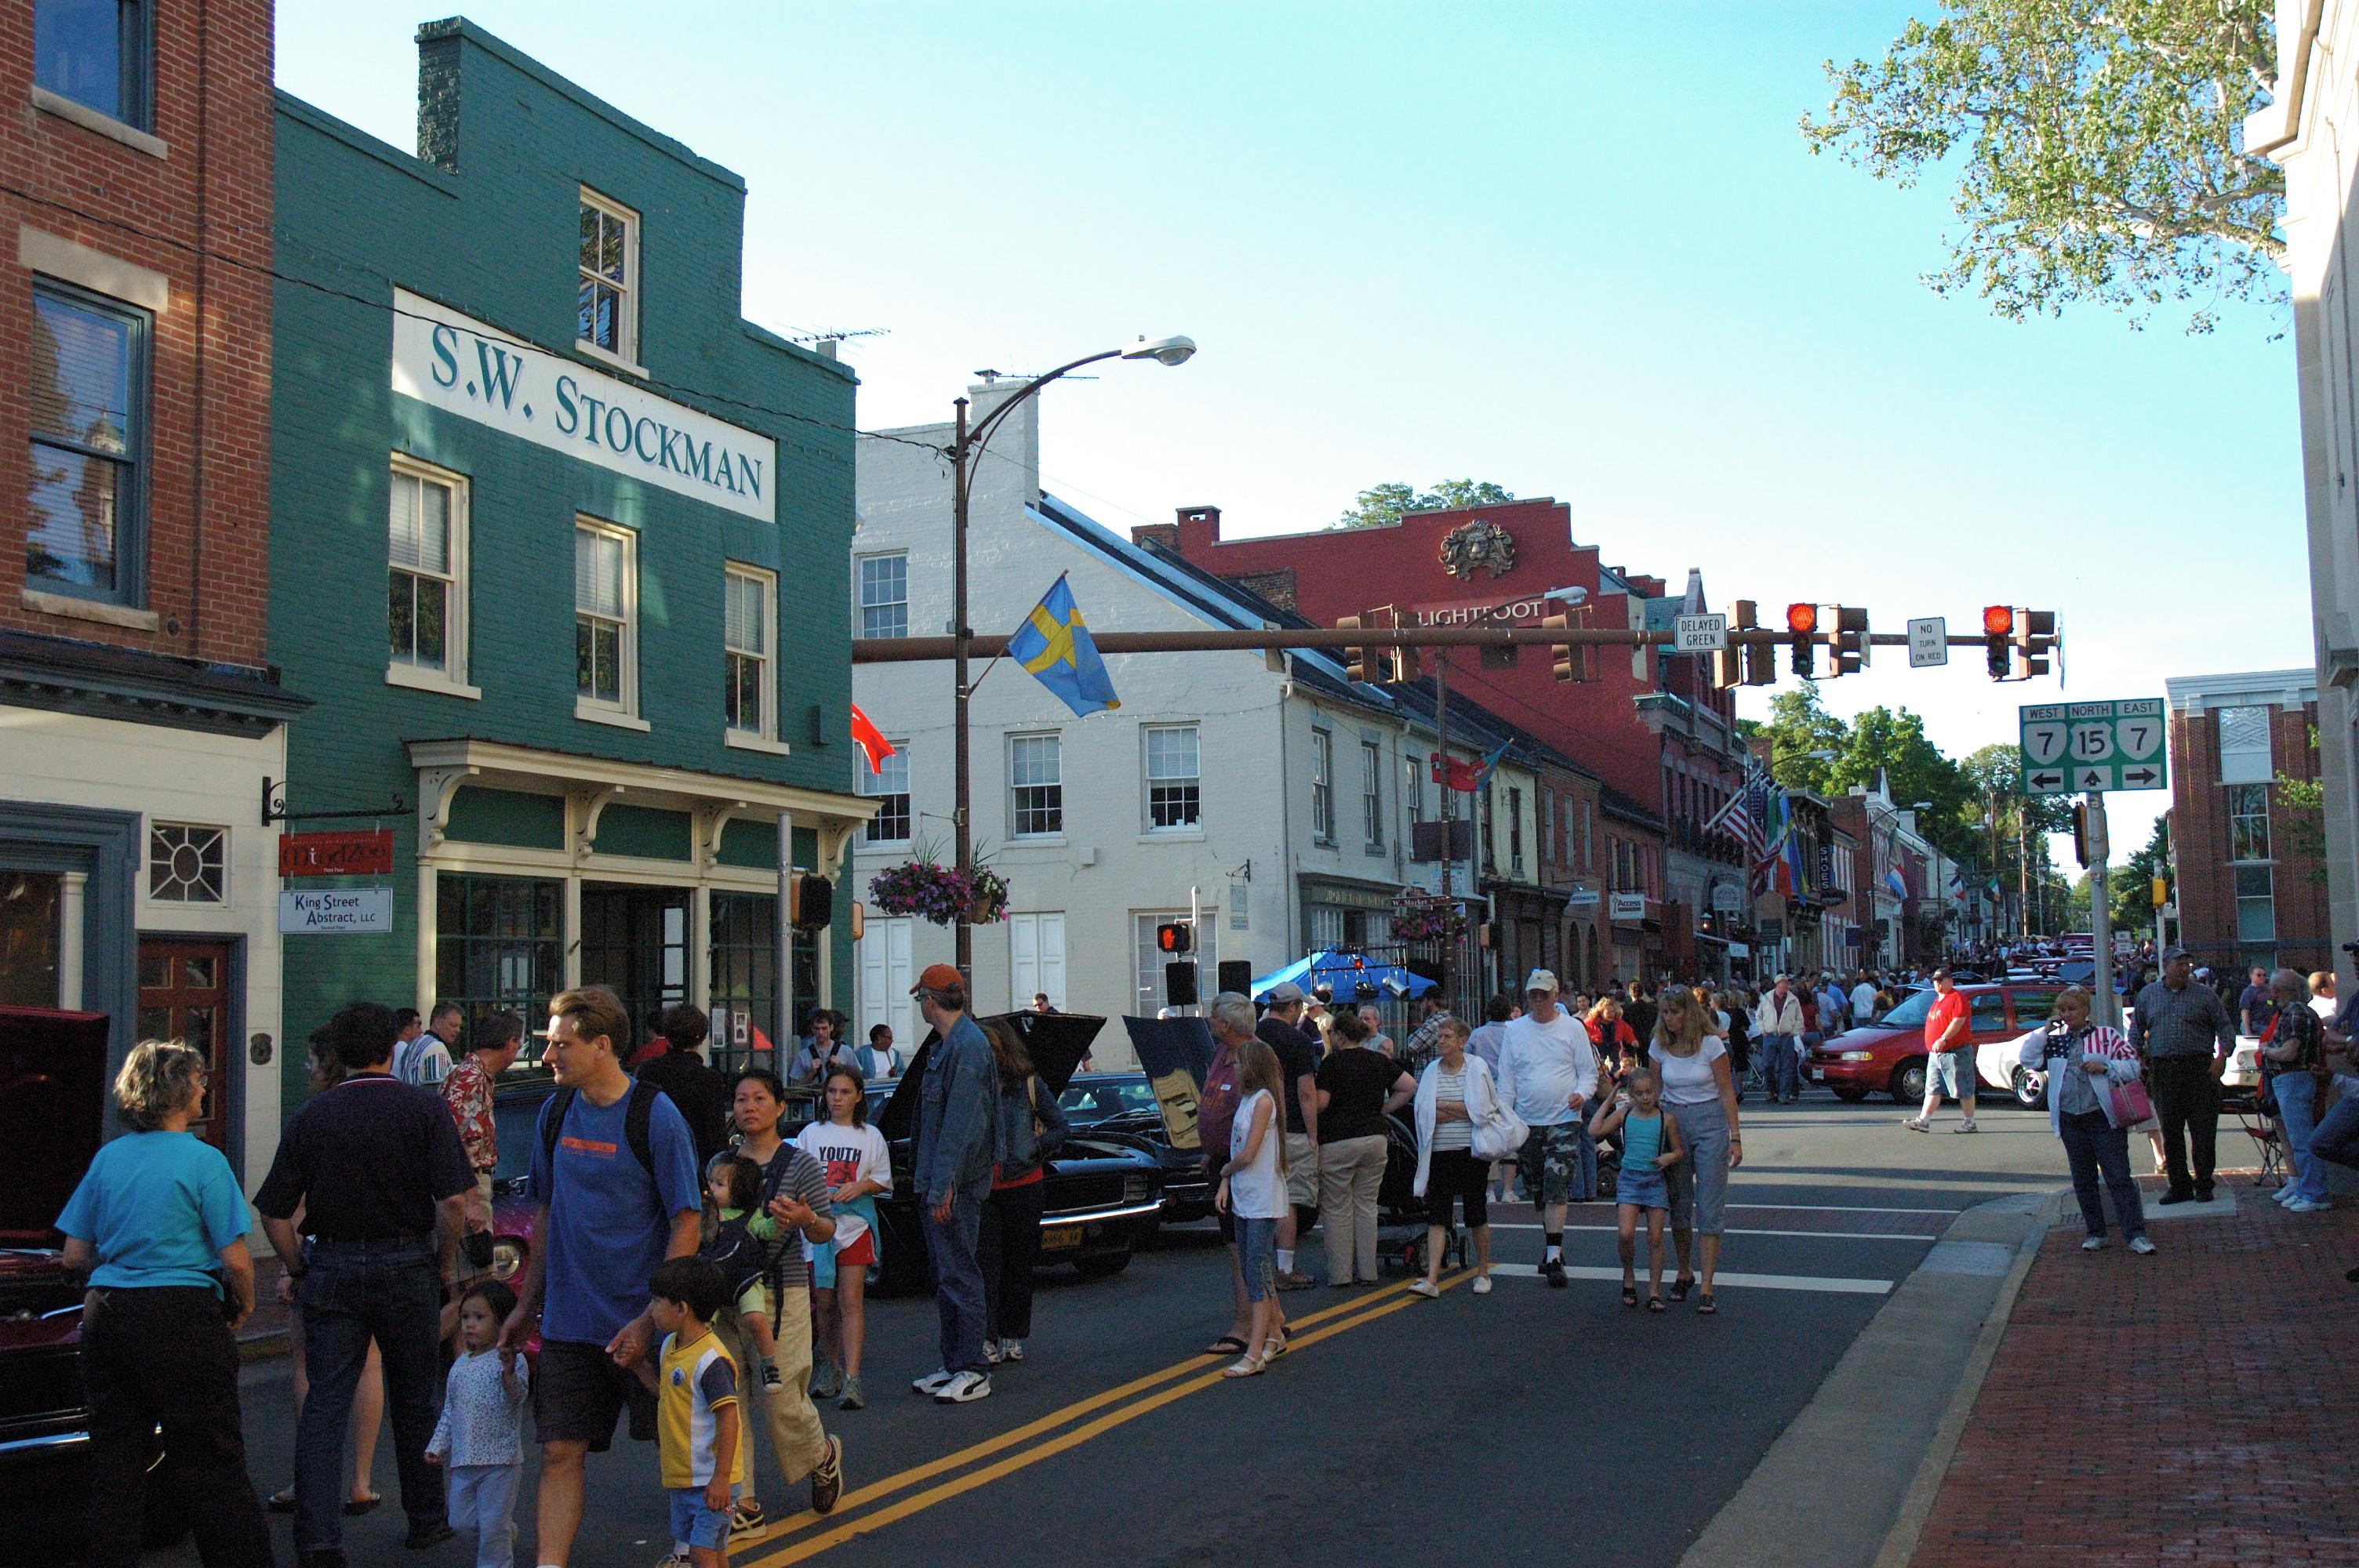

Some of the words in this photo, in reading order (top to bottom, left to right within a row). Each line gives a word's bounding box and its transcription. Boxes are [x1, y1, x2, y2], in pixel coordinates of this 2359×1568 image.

[431, 325, 533, 420] S.W.
[555, 375, 762, 501] STOCKMAN
[1681, 619, 1720, 632] DELAYED
[1920, 624, 1932, 634] NO
[1687, 633, 1716, 646] GREEN
[1919, 639, 1936, 648] TURN
[1915, 653, 1925, 662] ON
[1928, 652, 1941, 660] RED
[2030, 707, 2059, 719] WEST
[2071, 704, 2110, 717] NORTH
[2124, 702, 2154, 713] EAST
[2037, 731, 2053, 756] 7
[2079, 730, 2106, 755] 15
[2131, 727, 2147, 751] 7
[1819, 847, 1830, 890] SHOES
[295, 894, 322, 910] King
[324, 894, 360, 911] Street
[306, 909, 357, 926] Abstract,
[360, 913, 376, 923] LLC
[819, 1146, 862, 1164] YOUTH
